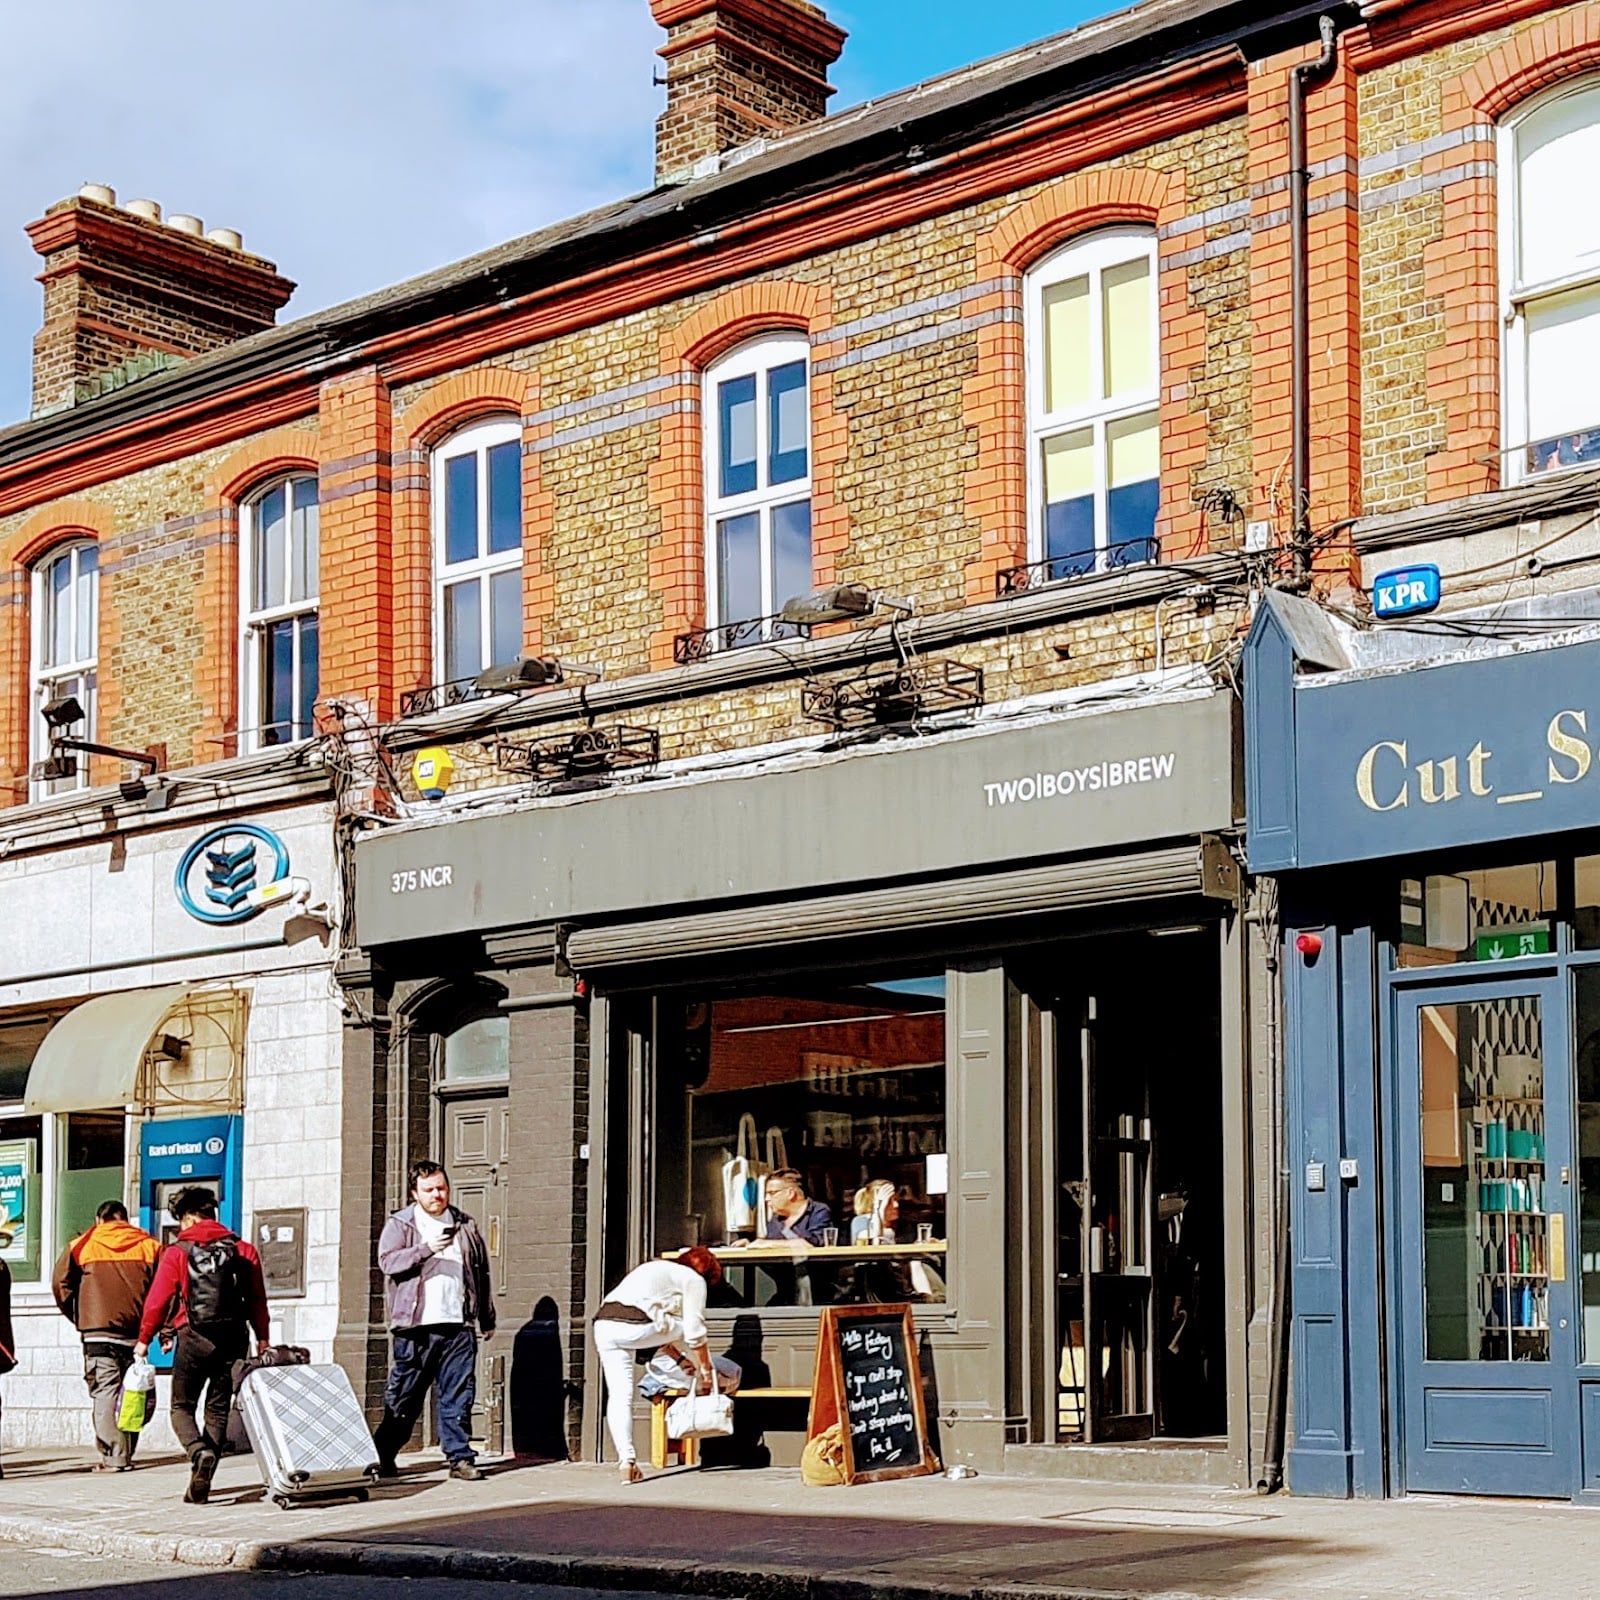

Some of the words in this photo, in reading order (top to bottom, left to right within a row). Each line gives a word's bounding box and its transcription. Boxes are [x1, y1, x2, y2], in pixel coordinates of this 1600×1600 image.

[1377, 580, 1428, 611] KPR
[1355, 709, 1600, 811] Cut_S
[391, 870, 417, 893] 375
[420, 865, 453, 889] NCR
[841, 1329, 863, 1347] Hello
